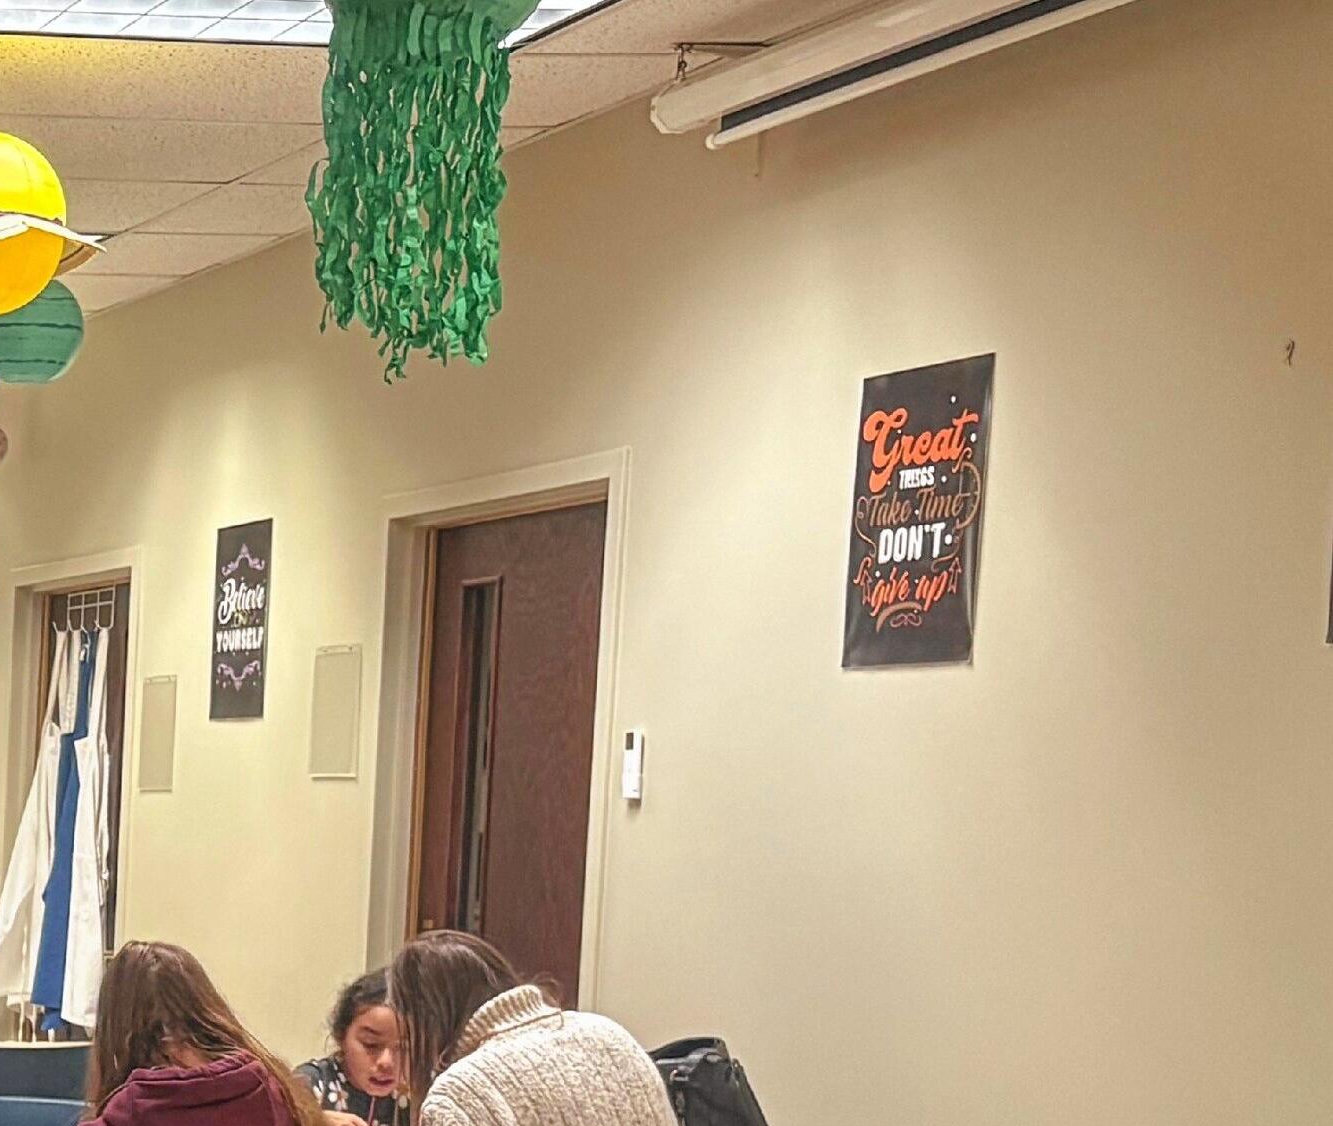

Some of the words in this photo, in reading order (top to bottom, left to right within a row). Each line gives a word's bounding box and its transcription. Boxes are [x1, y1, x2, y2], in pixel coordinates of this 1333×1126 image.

[863, 407, 979, 493] Great
[868, 491, 912, 526] Take
[916, 485, 968, 521] Time
[877, 521, 946, 565] DON'T
[217, 578, 265, 625] Believe
[870, 567, 910, 616] give
[915, 571, 949, 611] up
[215, 626, 264, 653] YOURSELF
